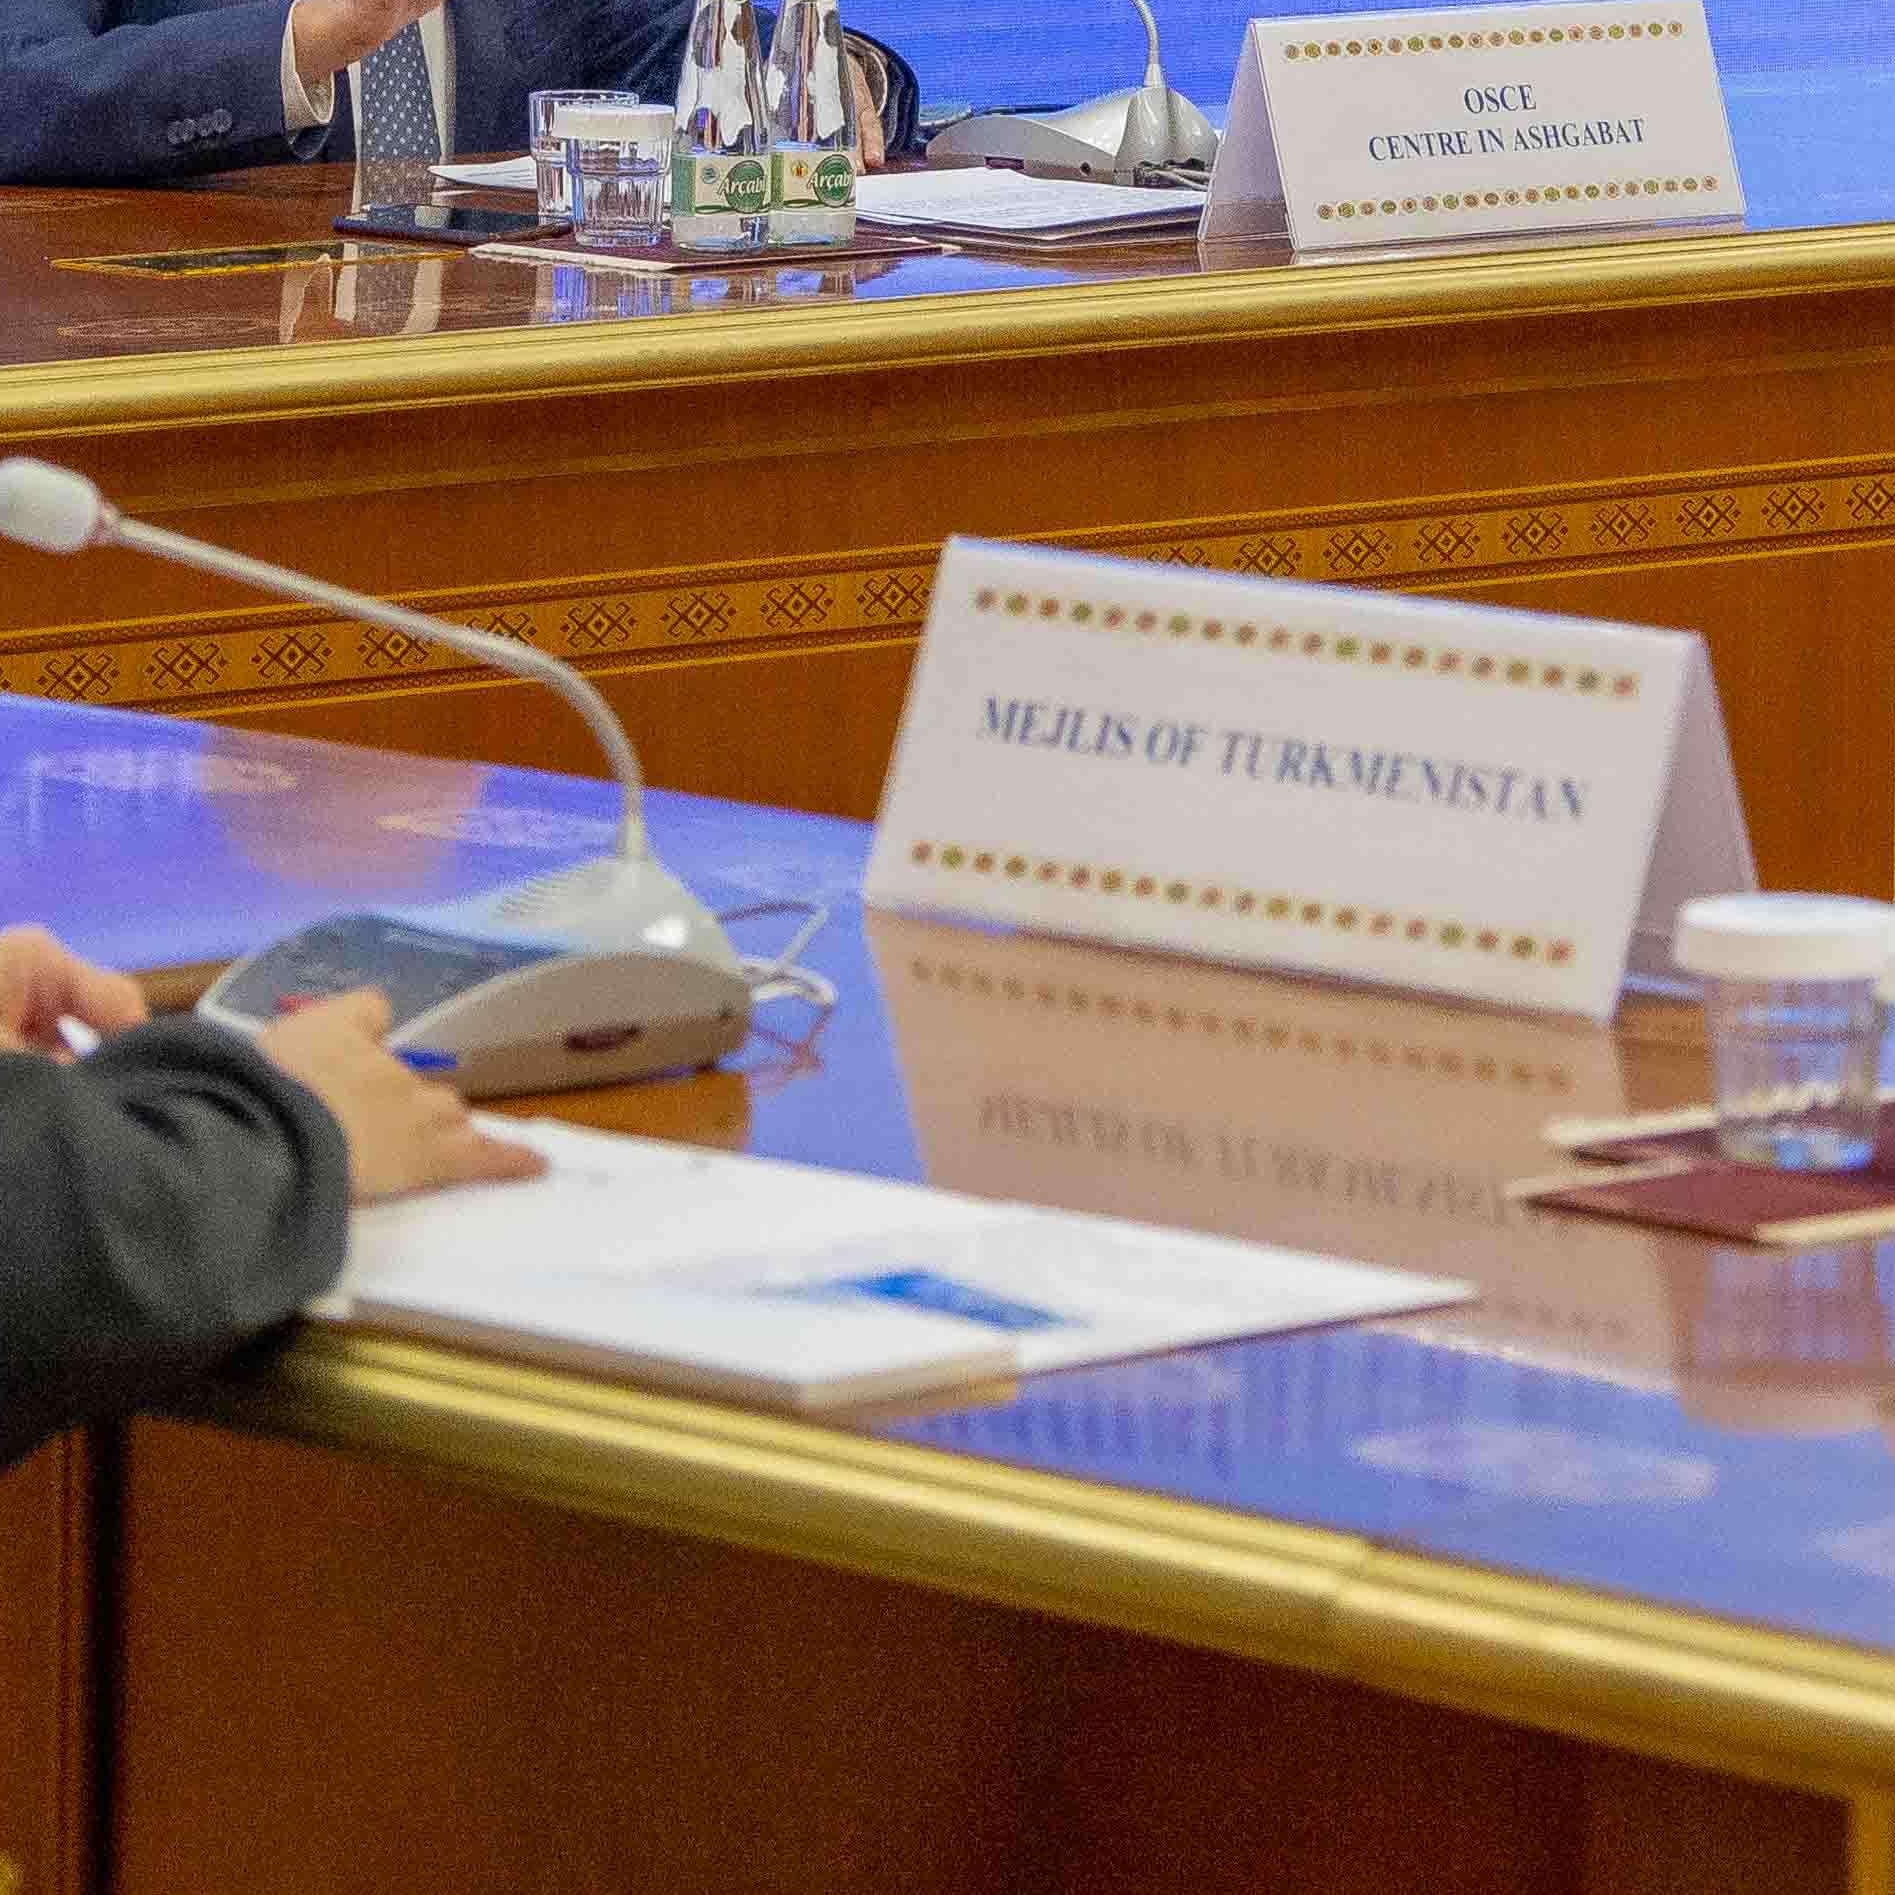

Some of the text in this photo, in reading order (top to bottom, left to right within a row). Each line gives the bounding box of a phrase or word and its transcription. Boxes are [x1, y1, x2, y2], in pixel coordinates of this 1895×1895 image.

[1463, 83, 1537, 114] OSCE
[1367, 117, 1644, 162] CENTRE IN ASHGABAT
[978, 694, 1590, 821] MEJLIS OF TURKMENISTAN
